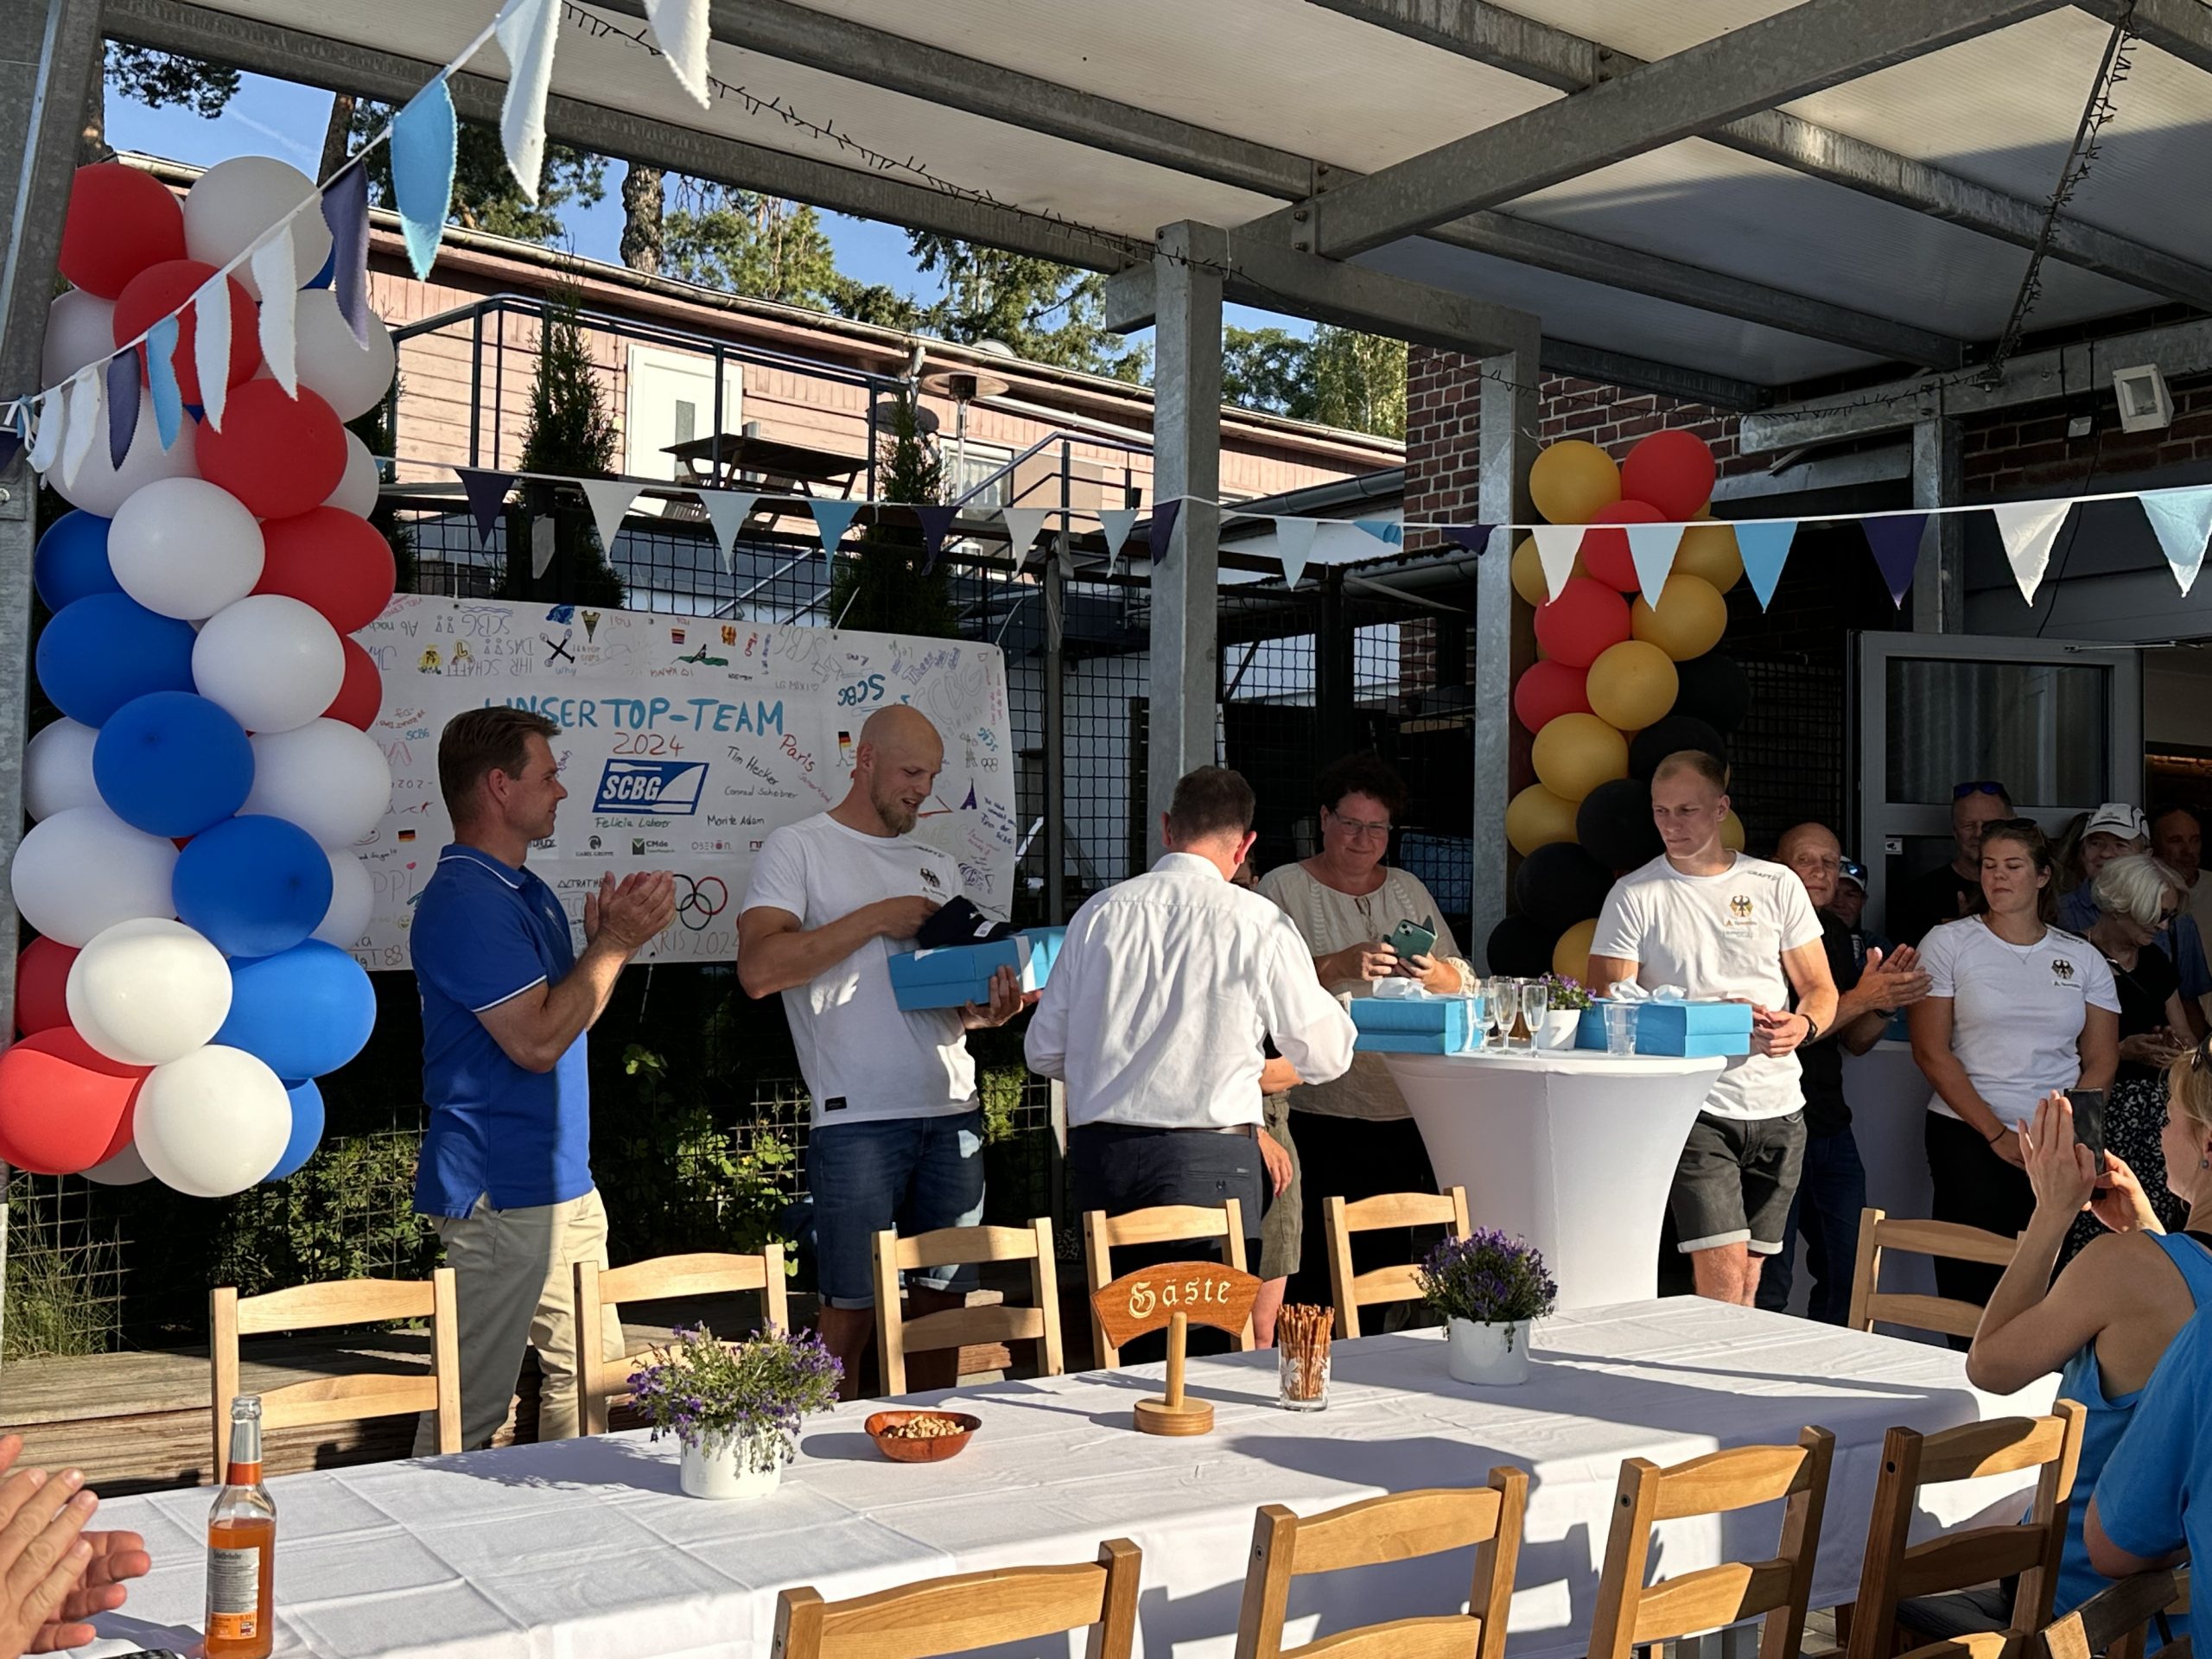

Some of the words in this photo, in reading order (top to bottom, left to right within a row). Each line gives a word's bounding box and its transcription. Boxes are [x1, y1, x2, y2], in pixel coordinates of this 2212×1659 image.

[509, 657, 533, 674] IHR
[600, 696, 785, 738] TOP-TEAM
[612, 732, 685, 757] 2024
[779, 734, 817, 772] Paris
[601, 774, 663, 802] SCBG
[740, 814, 765, 826] Adam
[1128, 1276, 1232, 1319] Gäste
